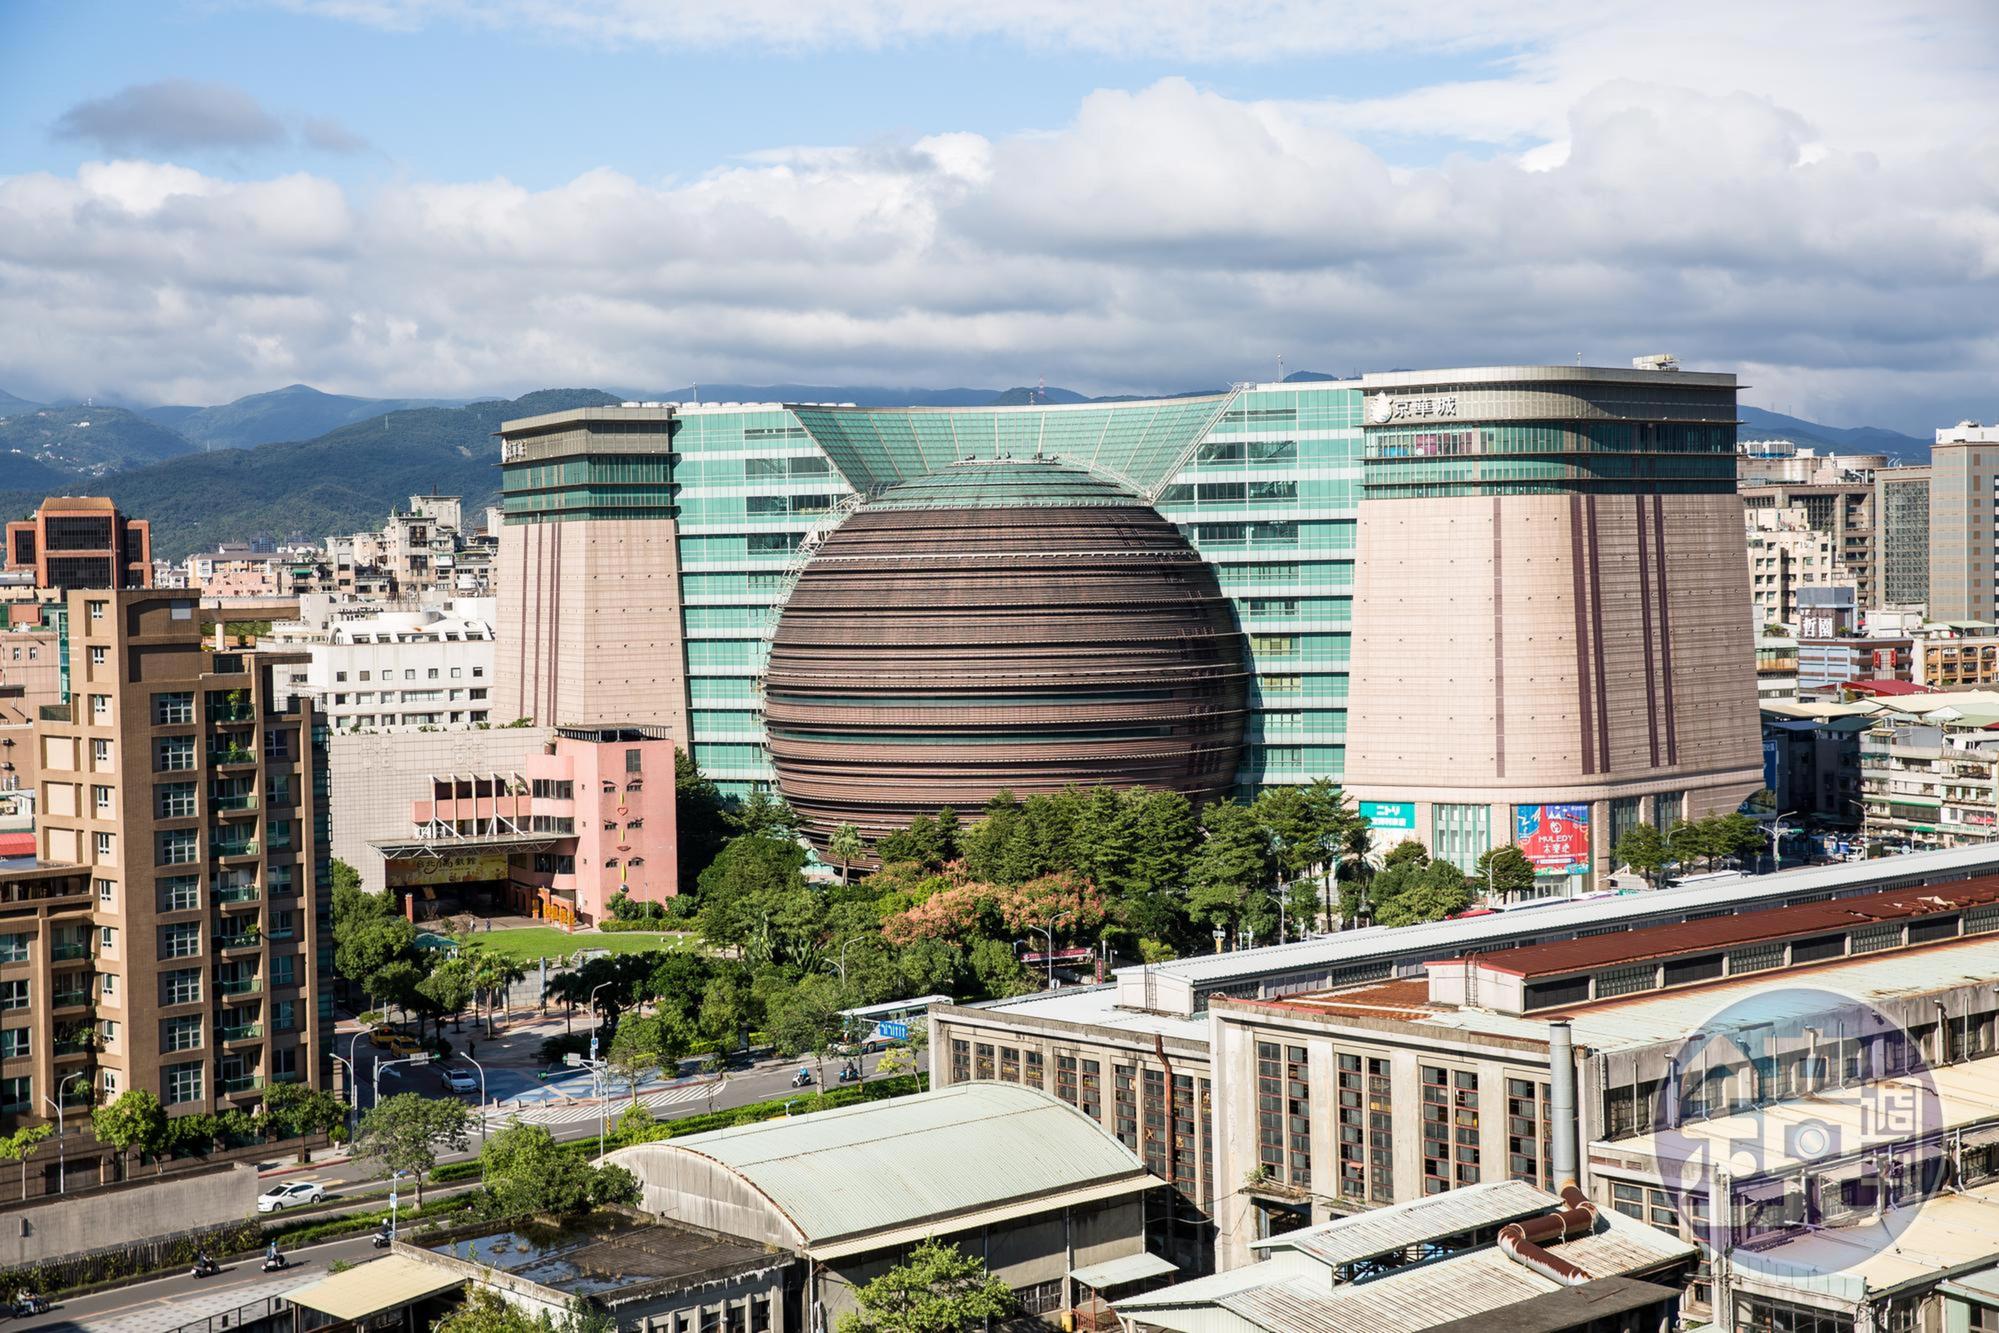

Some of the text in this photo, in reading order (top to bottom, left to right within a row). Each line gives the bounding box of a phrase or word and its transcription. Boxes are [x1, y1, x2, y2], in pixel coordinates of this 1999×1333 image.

[1394, 397, 1457, 419] 京華城
[1376, 805, 1401, 816] ニトリ
[1538, 834, 1574, 843] MULEDY
